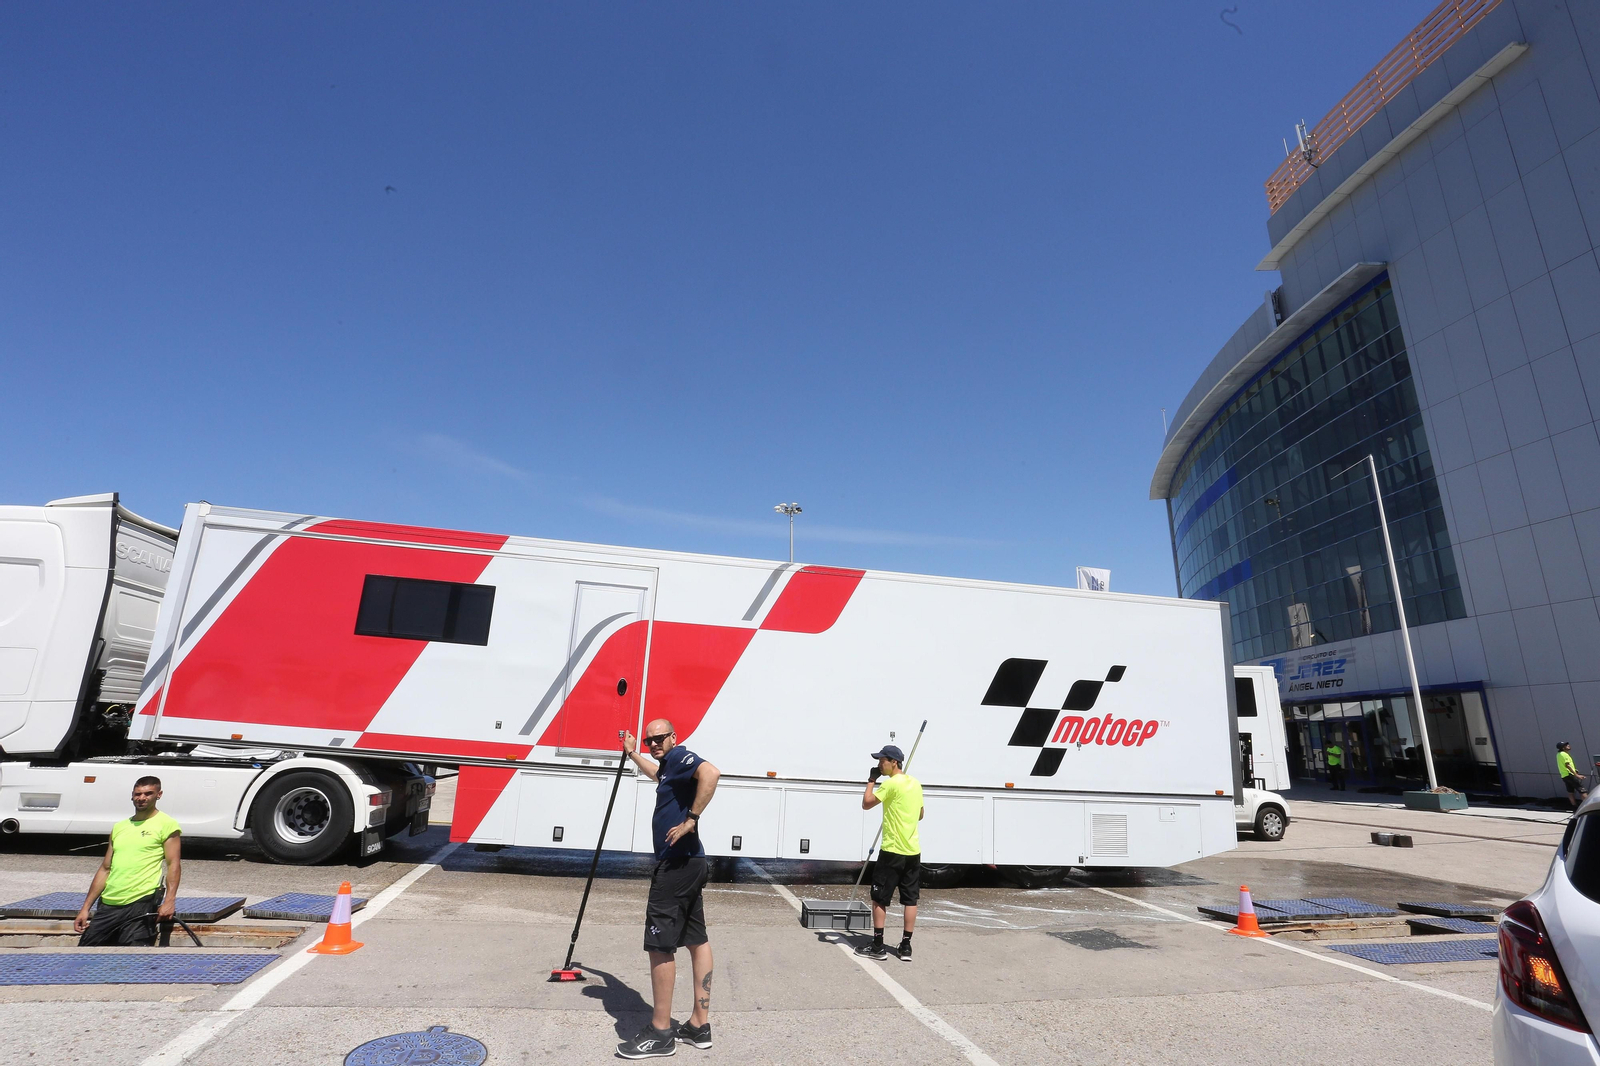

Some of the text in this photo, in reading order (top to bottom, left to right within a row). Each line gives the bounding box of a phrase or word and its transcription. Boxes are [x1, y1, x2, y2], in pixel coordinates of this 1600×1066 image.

[1302, 652, 1328, 661] CIRCUITO
[1290, 658, 1347, 680] JEREZ
[1288, 678, 1344, 692] ÁNGEL NIETO
